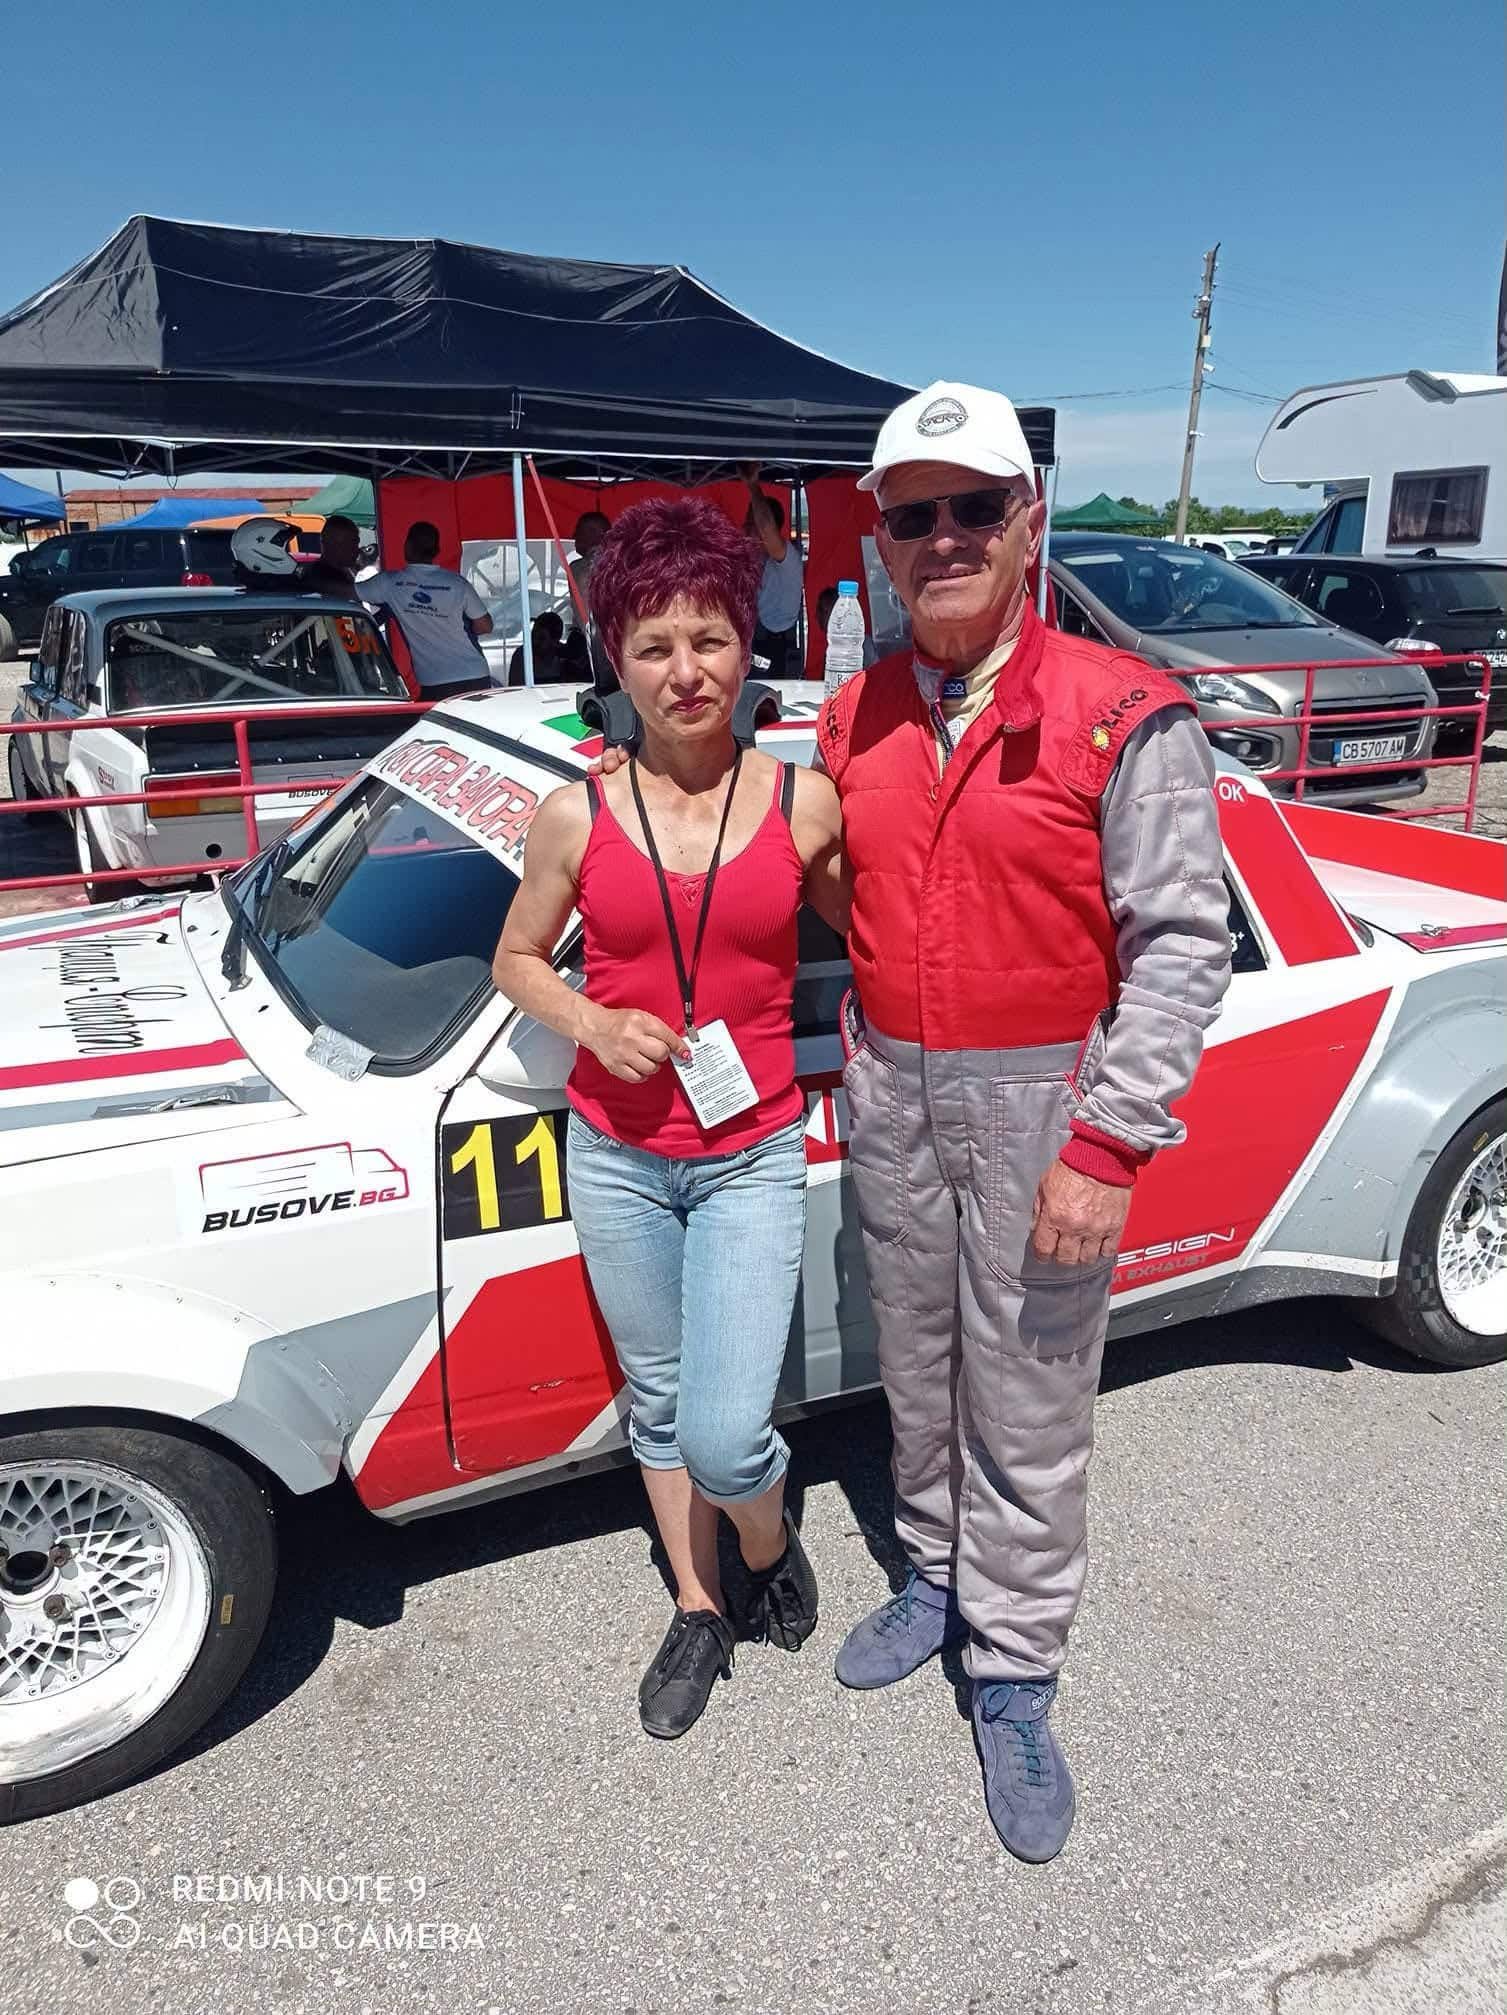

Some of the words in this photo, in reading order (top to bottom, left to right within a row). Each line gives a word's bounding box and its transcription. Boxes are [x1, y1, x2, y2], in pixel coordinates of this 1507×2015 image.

[1342, 743, 1360, 760] CB
[1360, 740, 1388, 758] 5707
[1218, 781, 1247, 803] OK
[451, 1114, 563, 1230] 11
[201, 1186, 398, 1234] BUSOVE.BG
[1116, 1226, 1236, 1268] ESIGN
[1127, 1253, 1208, 1280] EXHAUST
